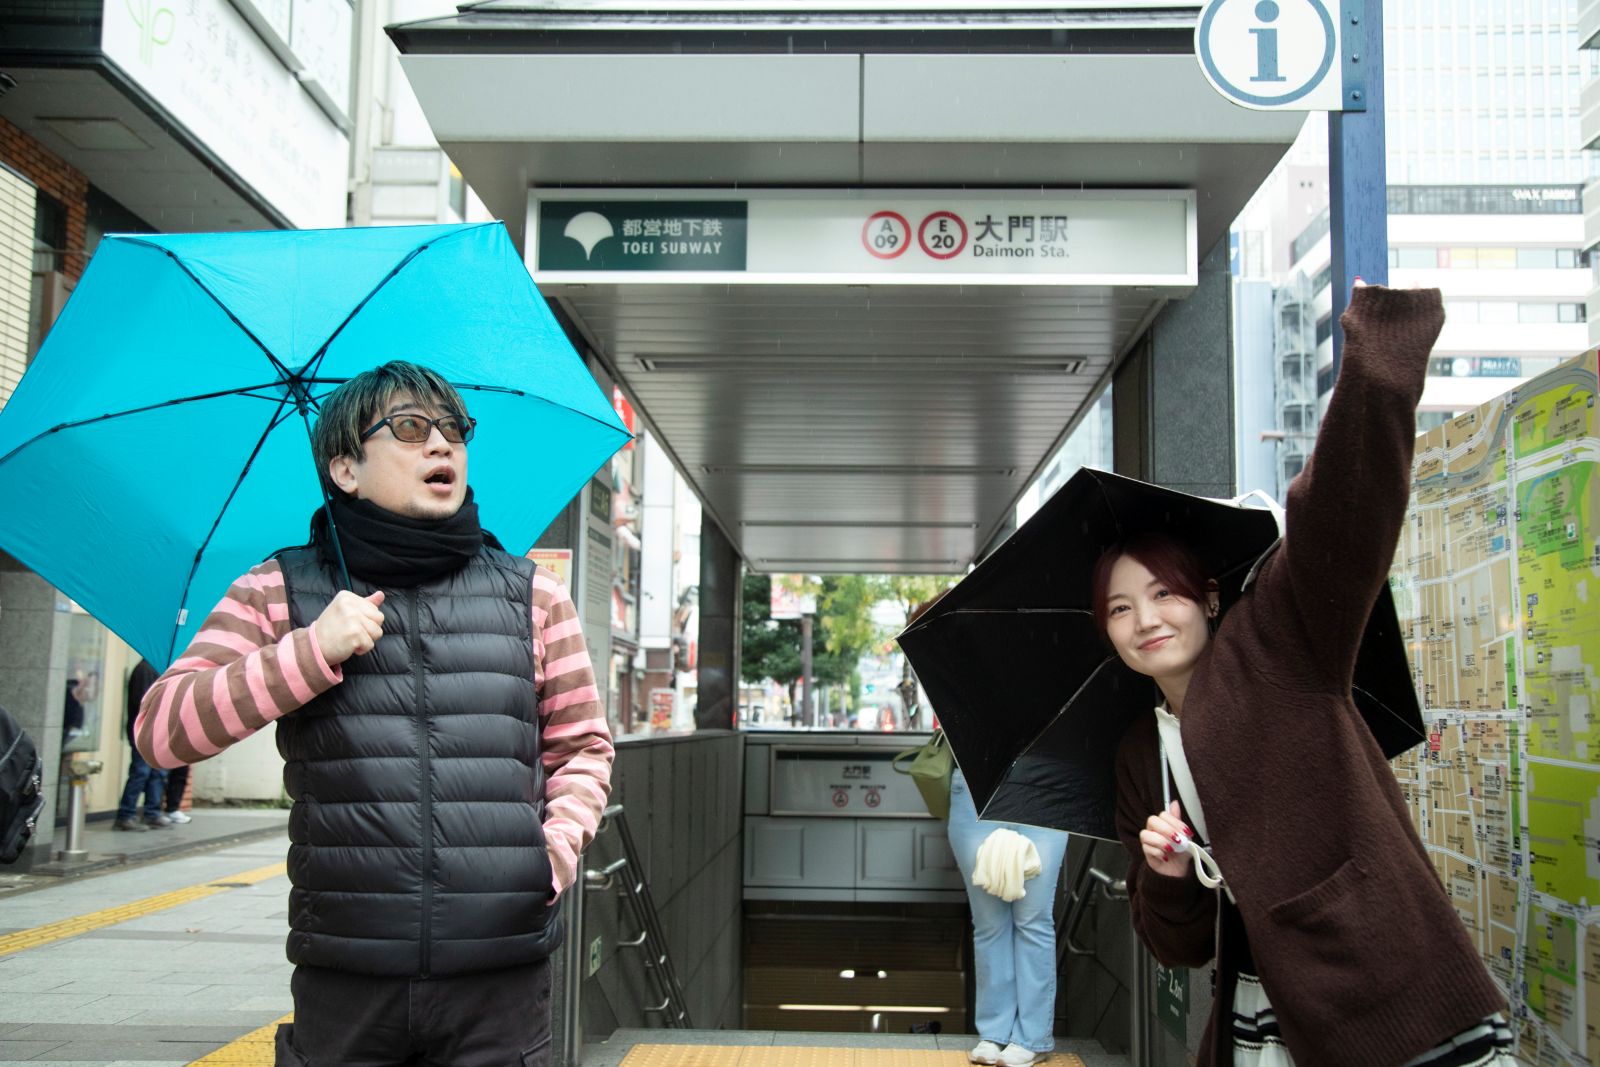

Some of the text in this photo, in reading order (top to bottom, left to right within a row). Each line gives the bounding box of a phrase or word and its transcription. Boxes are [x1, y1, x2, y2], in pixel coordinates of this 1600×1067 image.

[623, 218, 723, 237] 都営地下鉄
[880, 219, 894, 233] A
[938, 219, 948, 233] E
[974, 214, 1069, 243] 大門駅
[622, 241, 722, 255] TOEI SUBWAY
[874, 234, 899, 249] 09
[930, 234, 955, 249] 20
[972, 244, 1071, 258] Daimon Sta.
